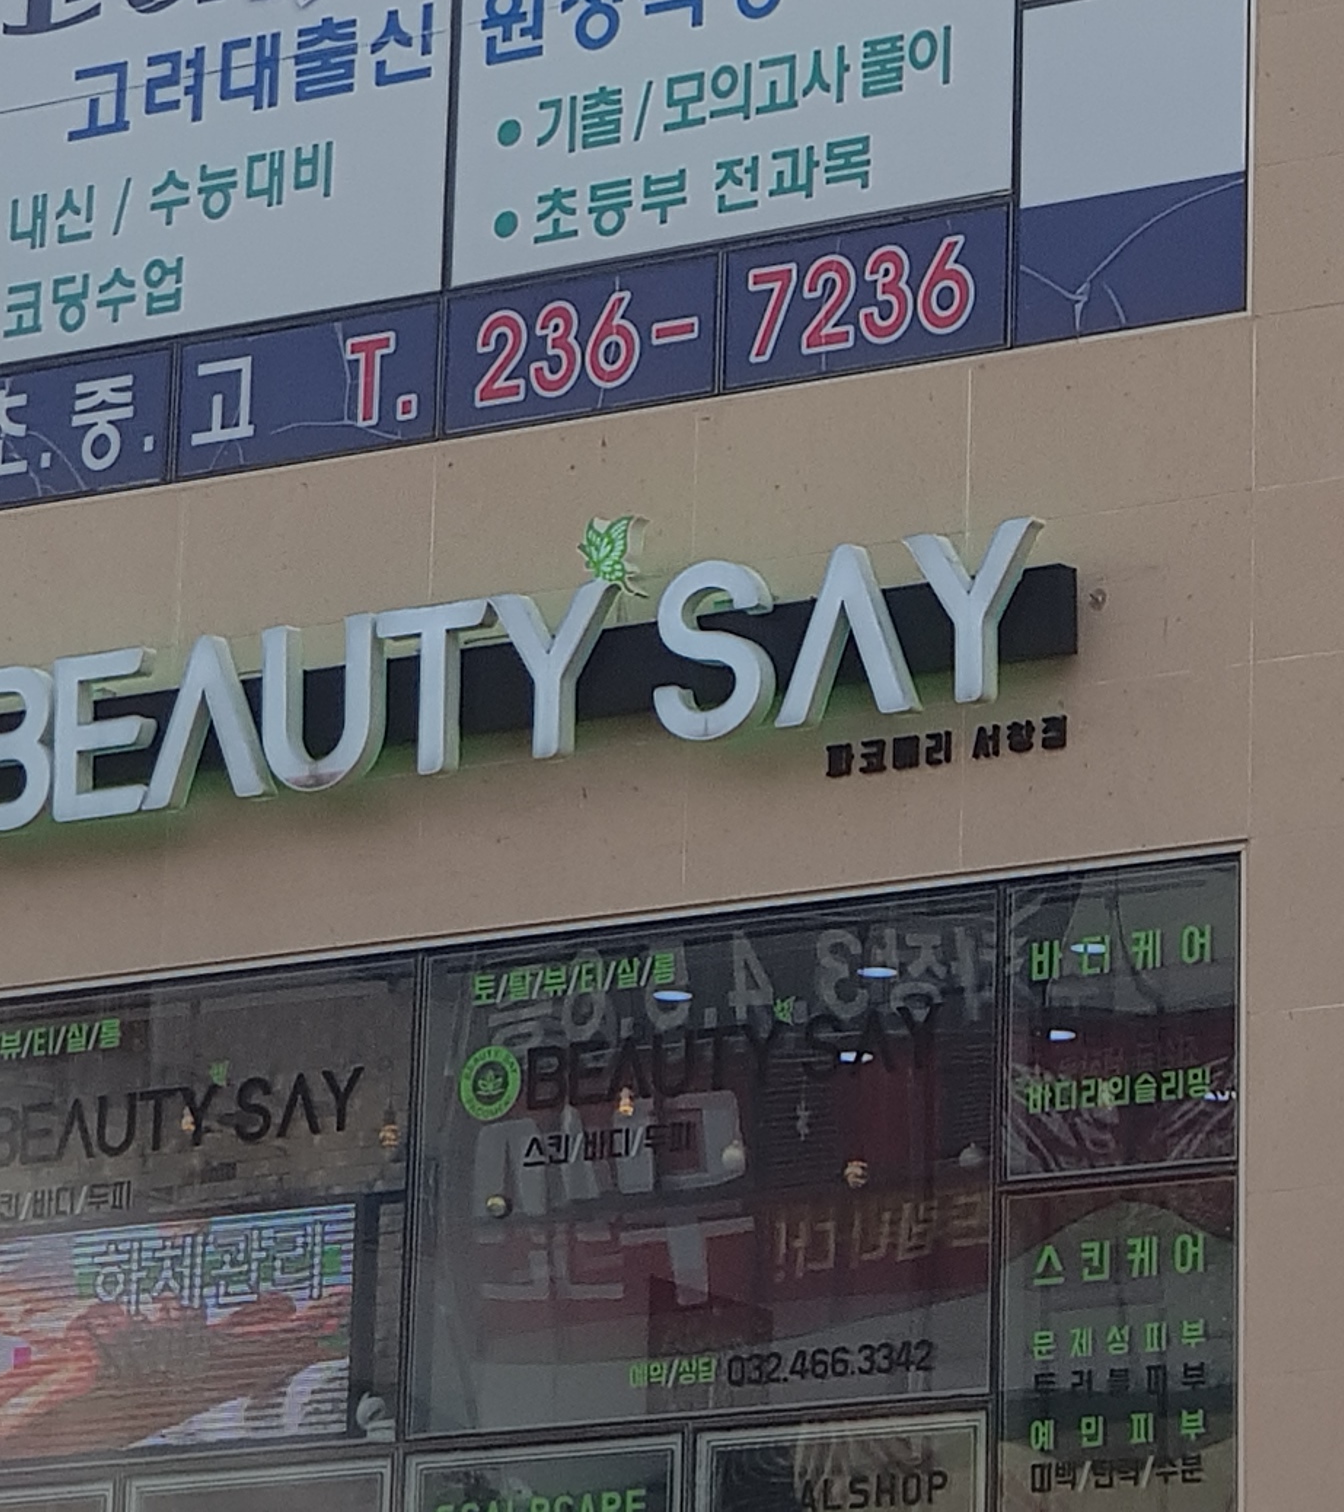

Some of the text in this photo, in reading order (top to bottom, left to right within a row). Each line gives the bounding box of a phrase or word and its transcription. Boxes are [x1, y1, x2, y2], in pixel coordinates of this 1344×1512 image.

[66, 2, 434, 142] 고려대출신
[534, 135, 872, 244] 초등부 전과목
[2, 256, 184, 339] 코딩수업
[655, 515, 1044, 741] SAY
[233, 1066, 365, 1144] SAY
[1032, 1233, 1206, 1285] 스킨케어
[726, 1339, 934, 1386] 032.466.3342
